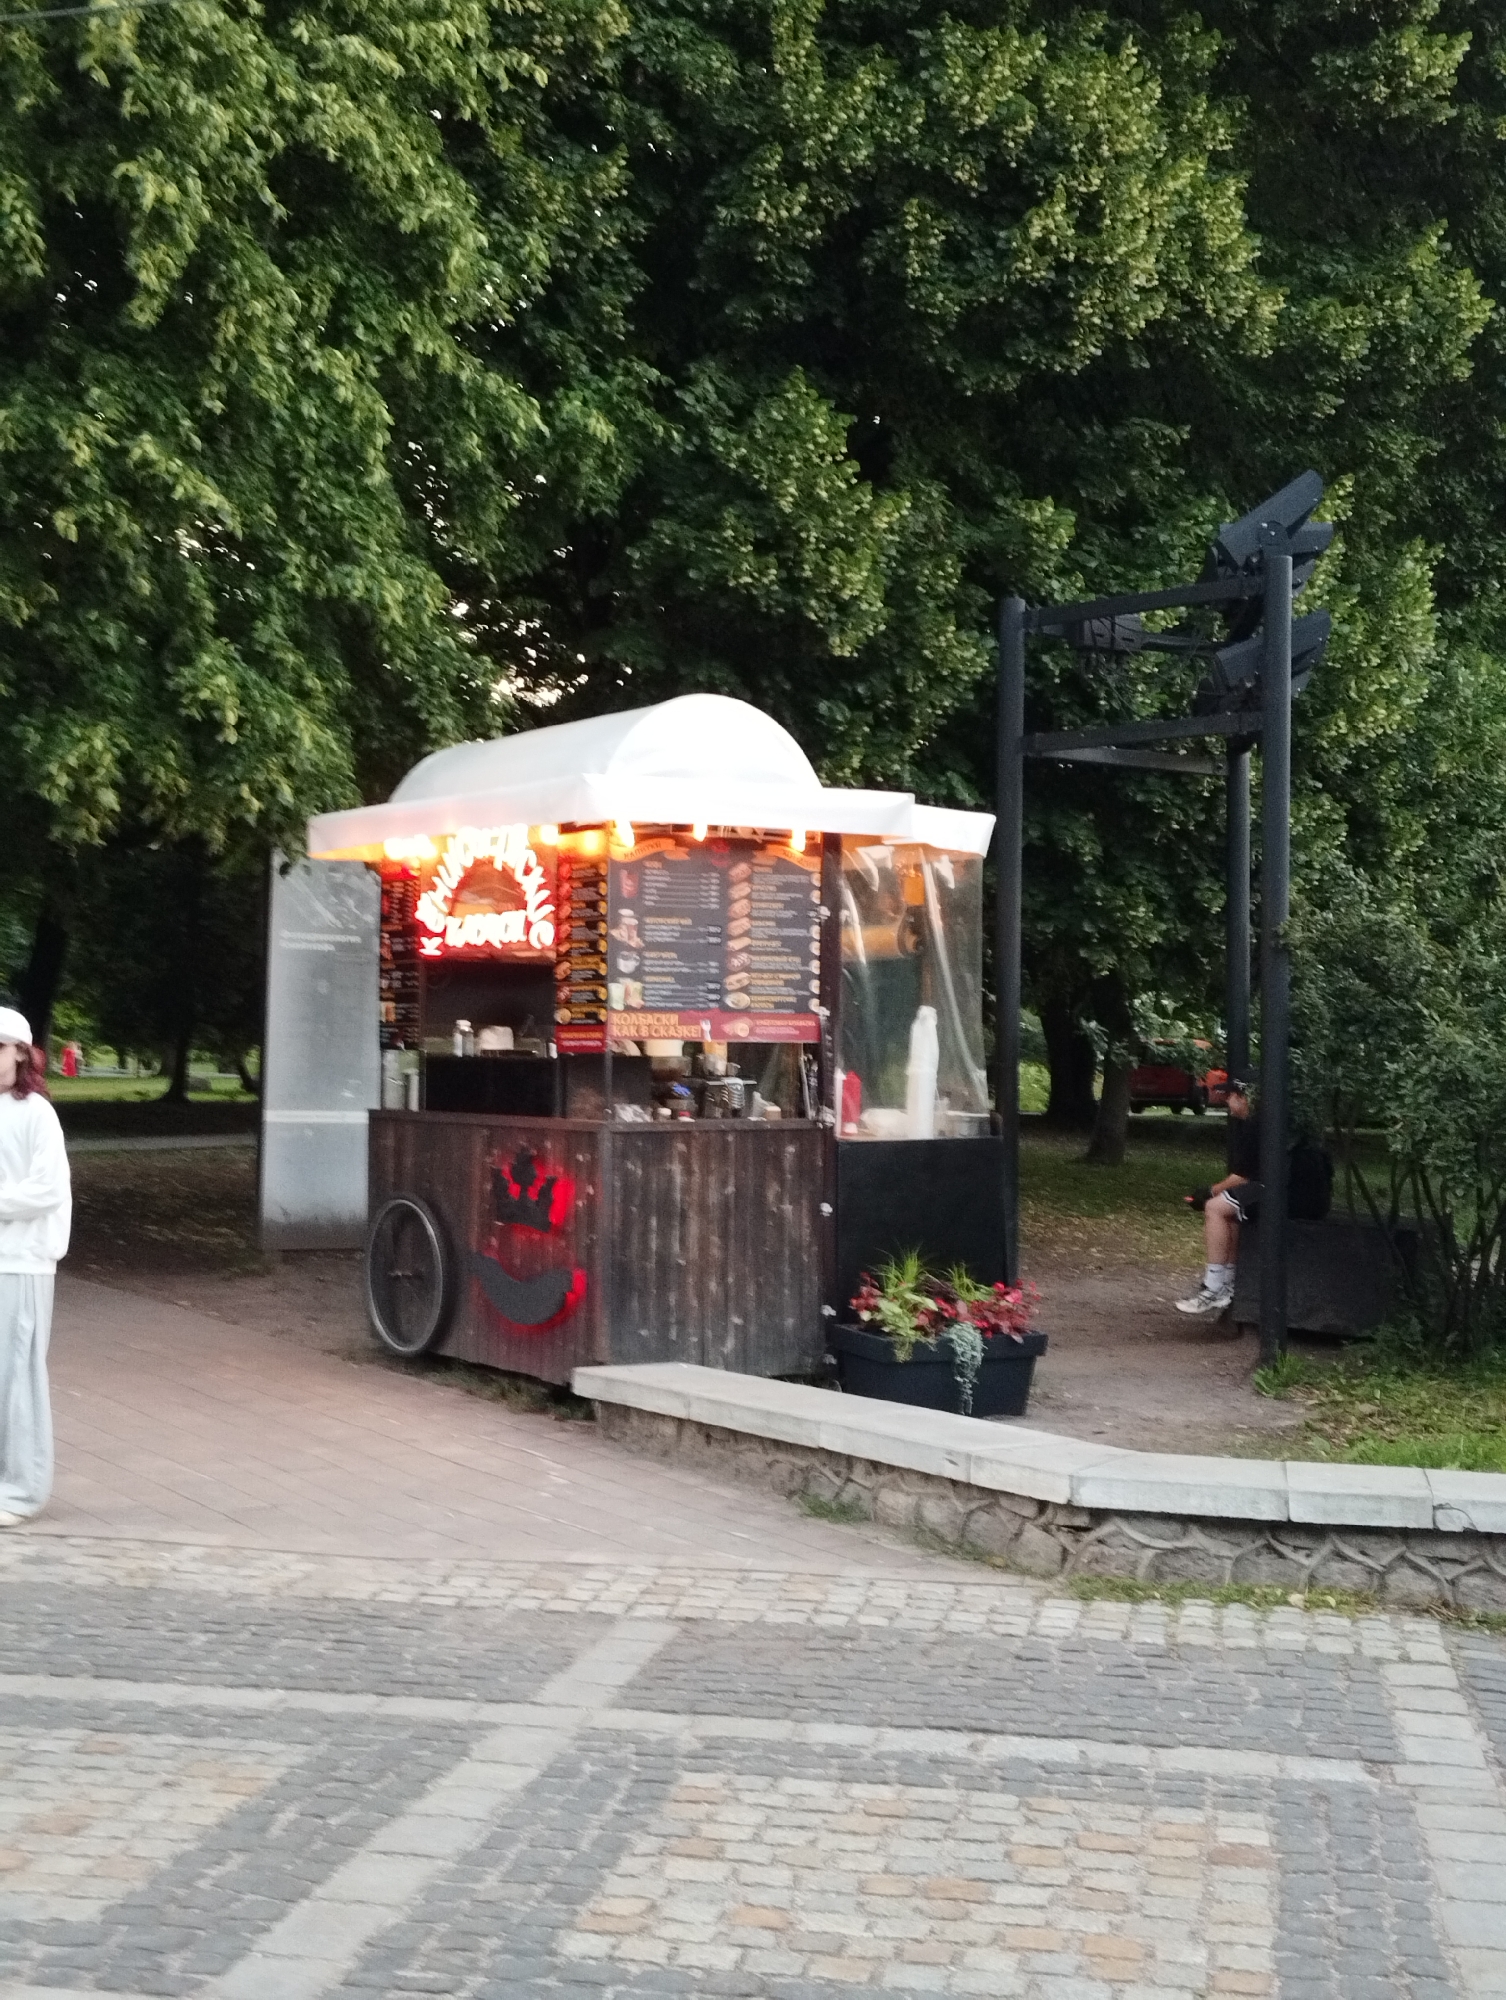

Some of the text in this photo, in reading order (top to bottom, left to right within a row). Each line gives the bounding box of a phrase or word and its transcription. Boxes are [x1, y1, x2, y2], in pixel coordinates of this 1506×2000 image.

[613, 1012, 679, 1026] КОЛБАСКИ
[613, 1025, 638, 1037] КАК
[640, 1025, 649, 1037] В
[651, 1025, 702, 1038] СКАЗКЕ!
